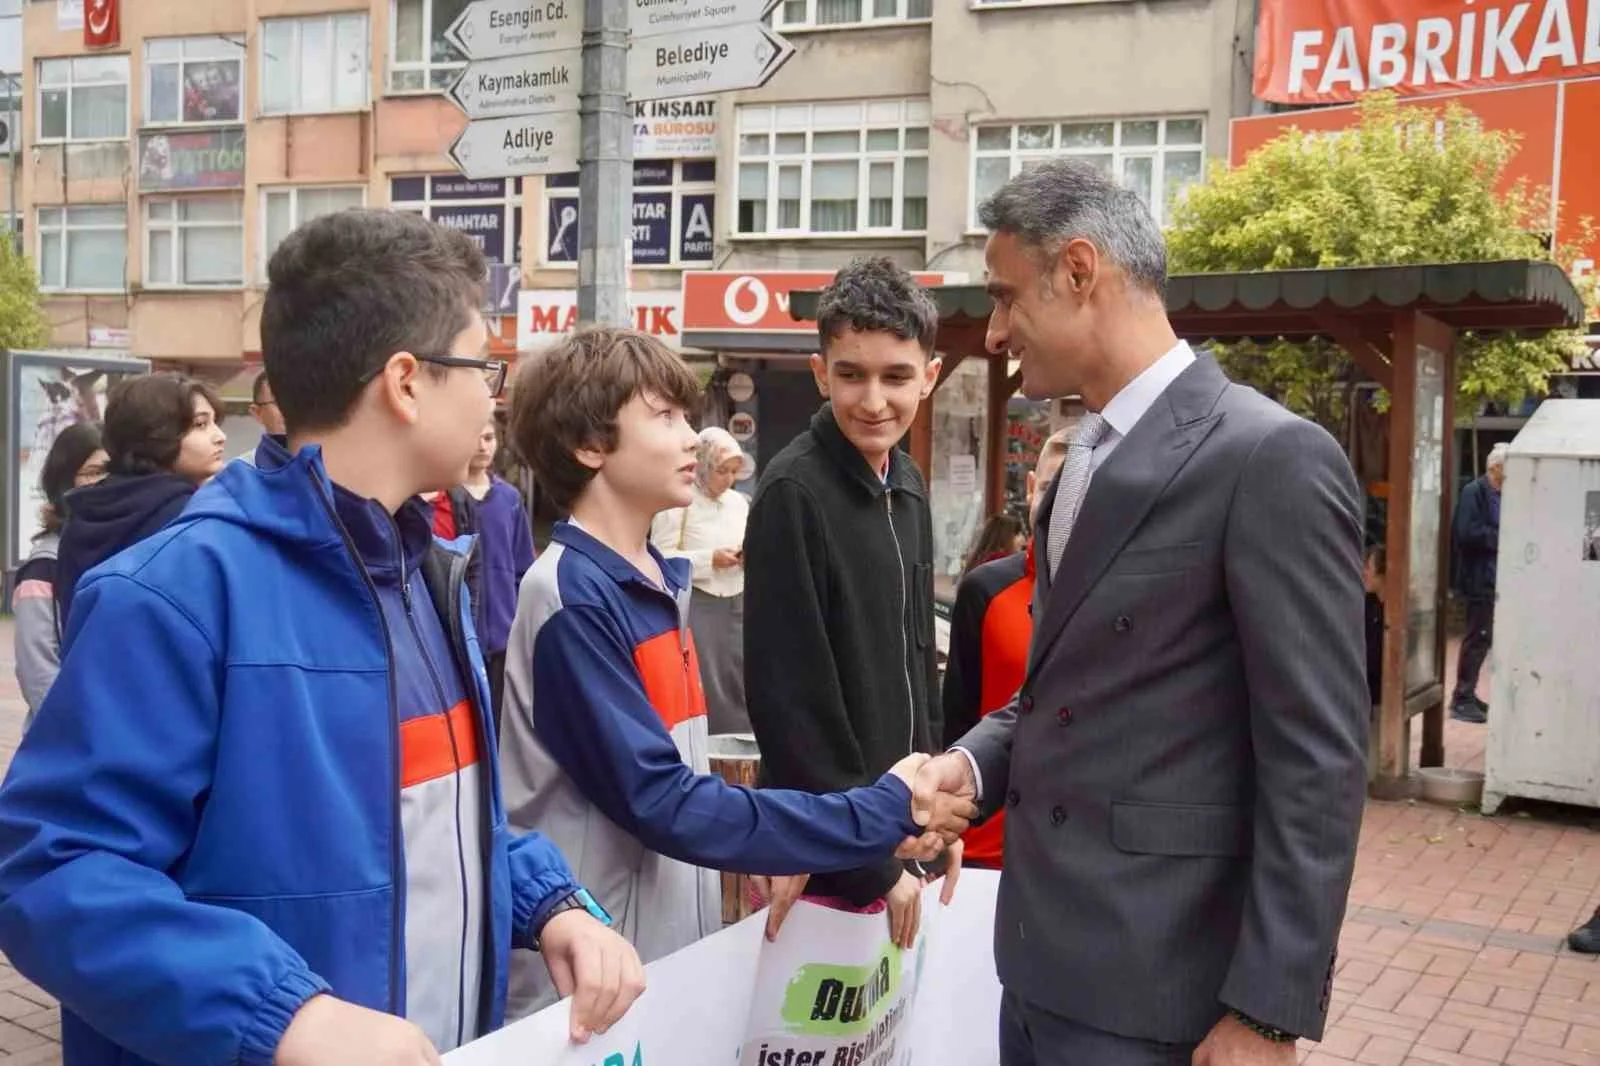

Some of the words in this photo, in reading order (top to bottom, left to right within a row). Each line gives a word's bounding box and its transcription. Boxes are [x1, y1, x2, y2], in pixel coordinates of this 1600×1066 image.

[489, 4, 542, 29] Esengin
[546, 1, 568, 20] Cd.
[704, 4, 737, 17] Square
[655, 41, 729, 68] Belediye
[478, 65, 569, 95] Kaymakamlık
[634, 100, 646, 118] K
[502, 126, 554, 151] Adliye
[437, 212, 500, 230] ANAHTAR
[685, 202, 713, 240] A
